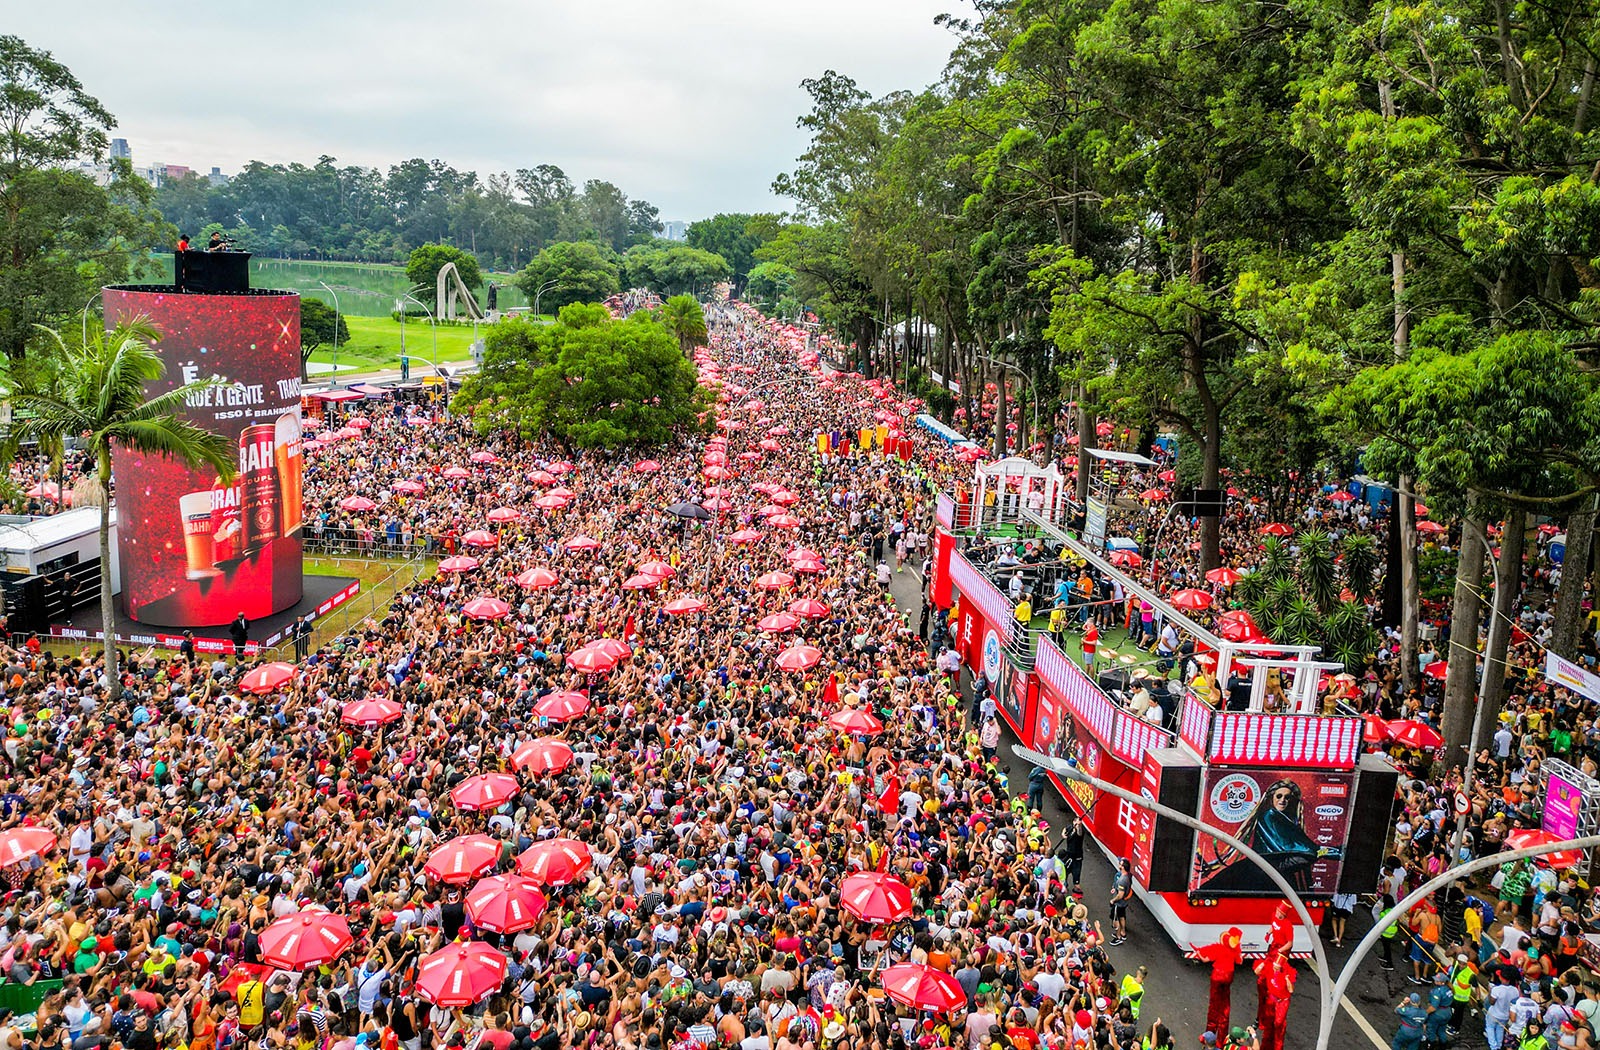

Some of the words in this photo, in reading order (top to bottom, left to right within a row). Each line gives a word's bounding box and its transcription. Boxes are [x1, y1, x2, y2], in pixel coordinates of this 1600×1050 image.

[226, 384, 265, 406] GENTE
[215, 410, 243, 420] ISSO
[245, 408, 253, 418] É
[61, 628, 87, 638] BRAHMA
[130, 634, 157, 645] BRAHMA
[197, 640, 224, 651] BRAHMA
[1320, 786, 1344, 795] BRAHMA
[304, 959, 322, 968] BRAHMA
[923, 1003, 939, 1011] BRAHMA
